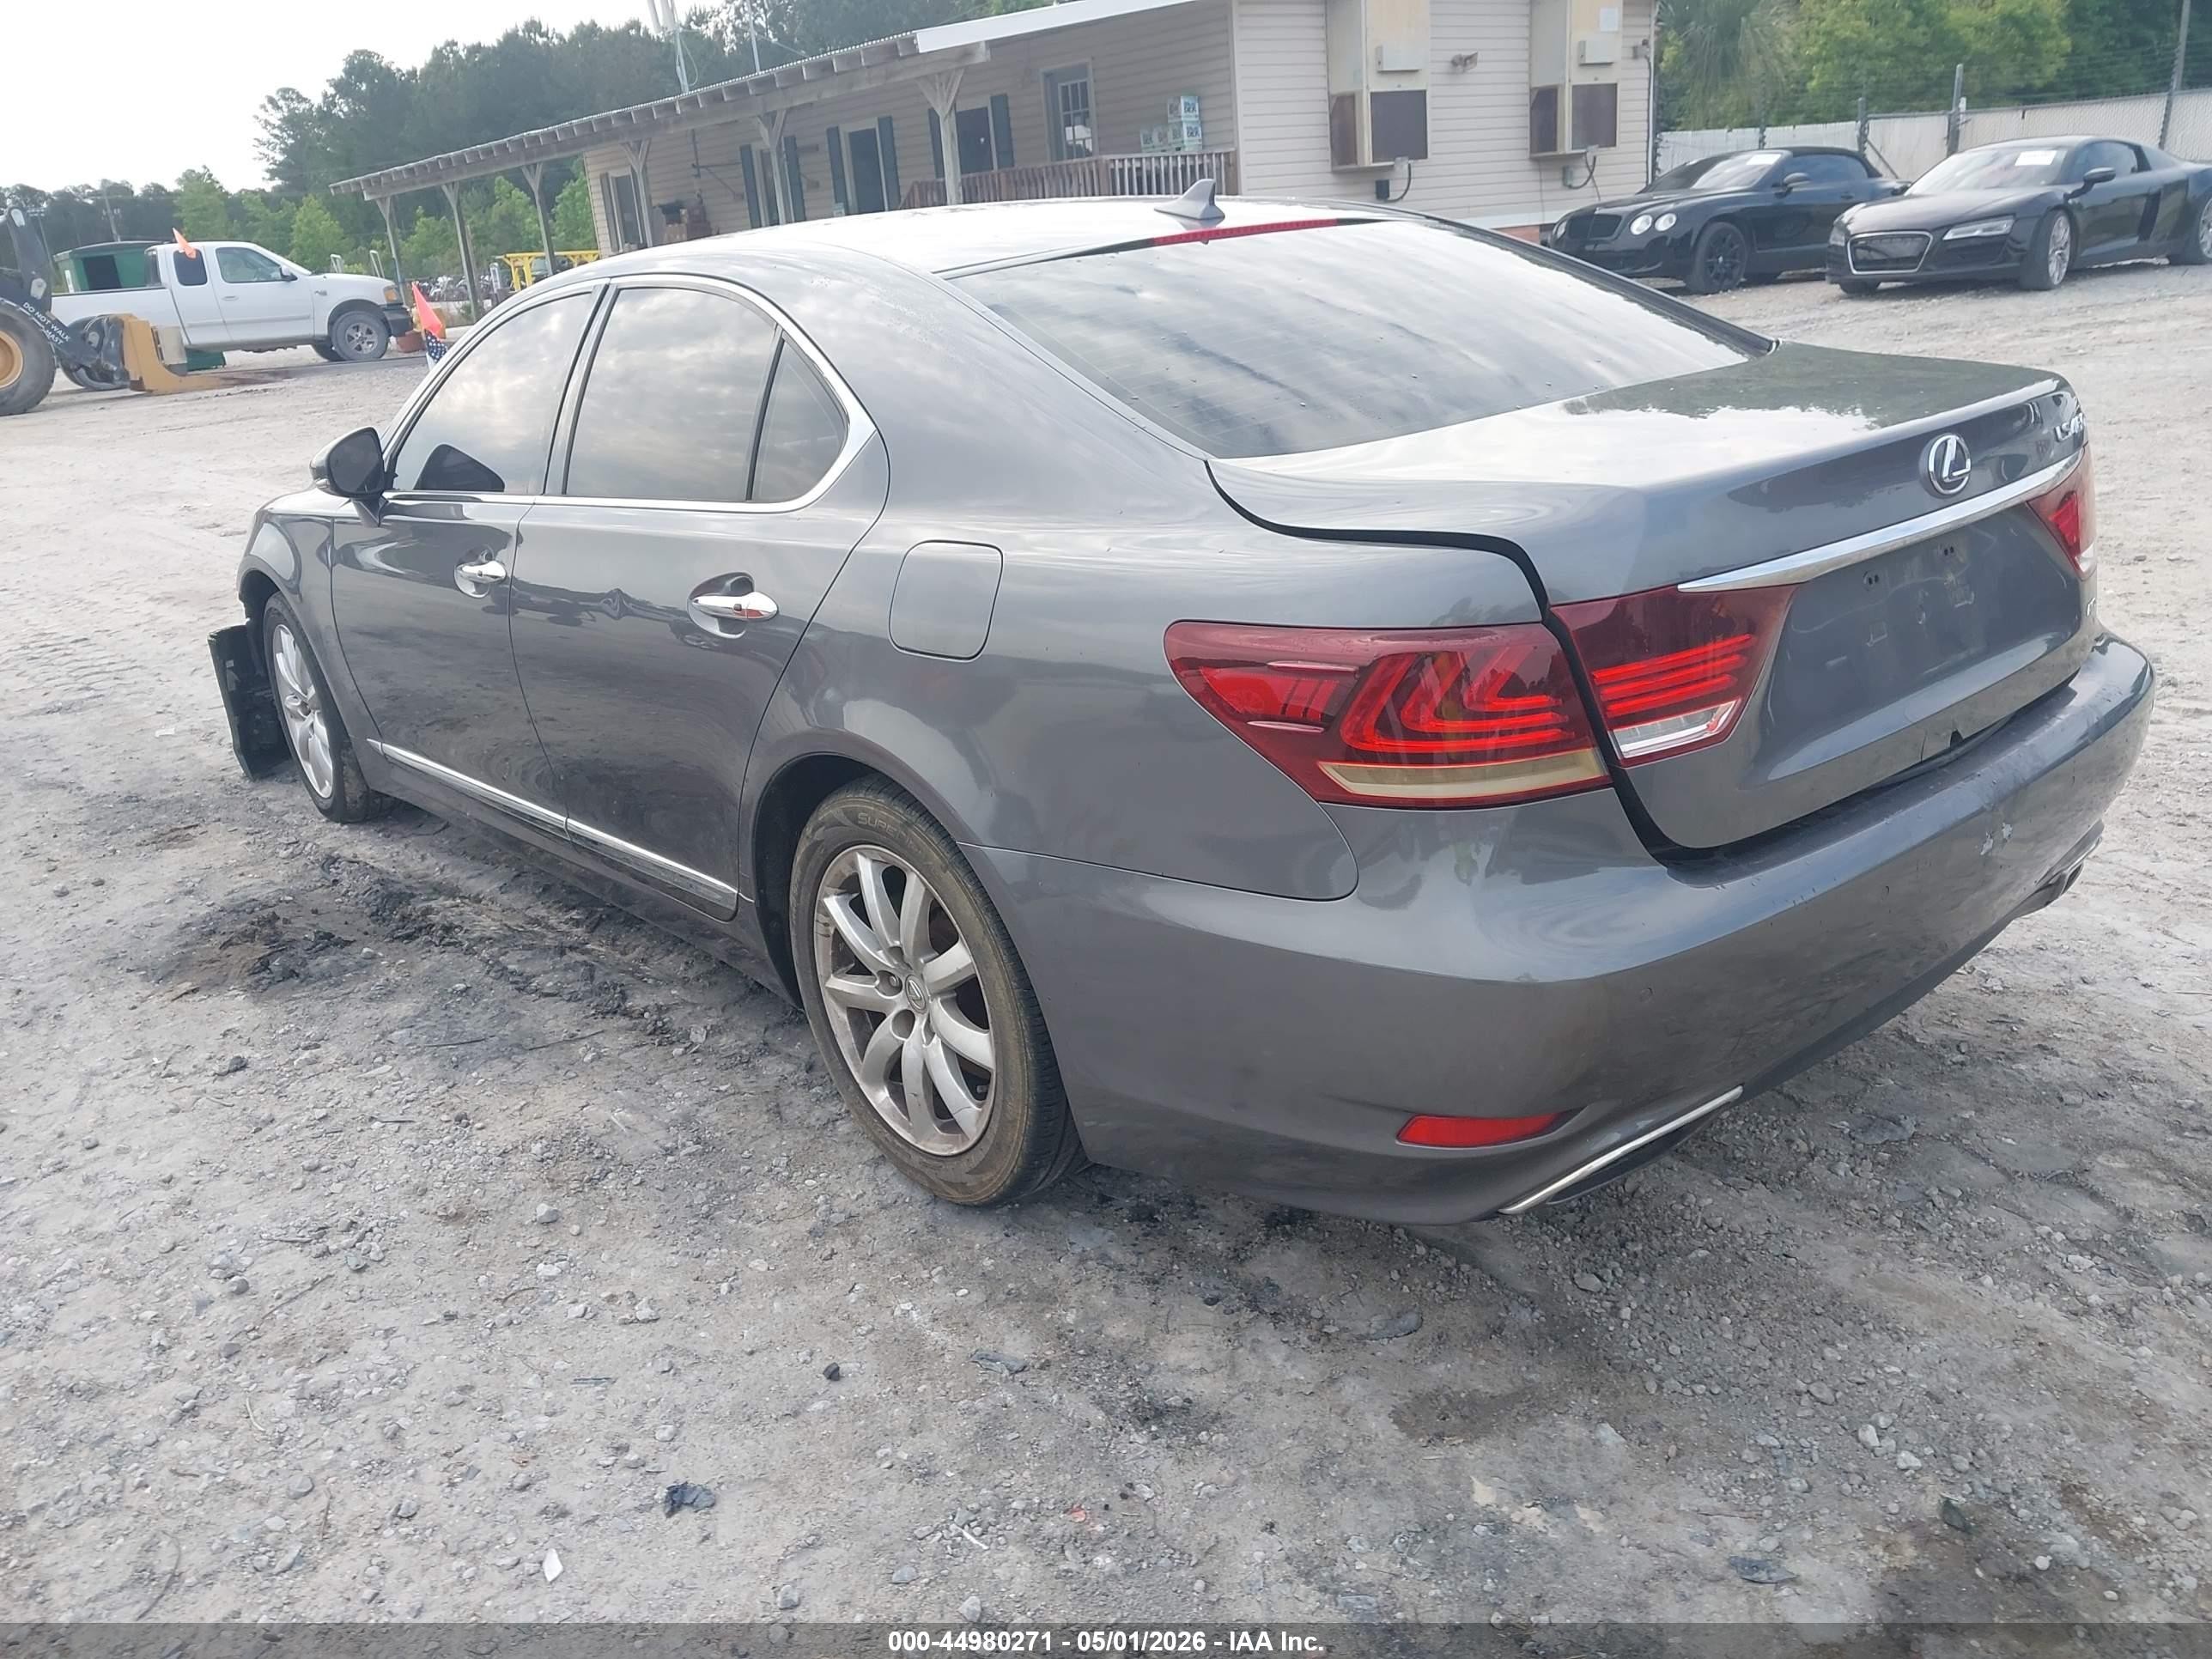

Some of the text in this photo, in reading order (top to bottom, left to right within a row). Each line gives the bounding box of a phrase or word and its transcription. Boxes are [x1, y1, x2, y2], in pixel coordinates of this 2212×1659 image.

[22, 301, 70, 342] DO NOT WALK
[46, 329, 64, 344] MAST
